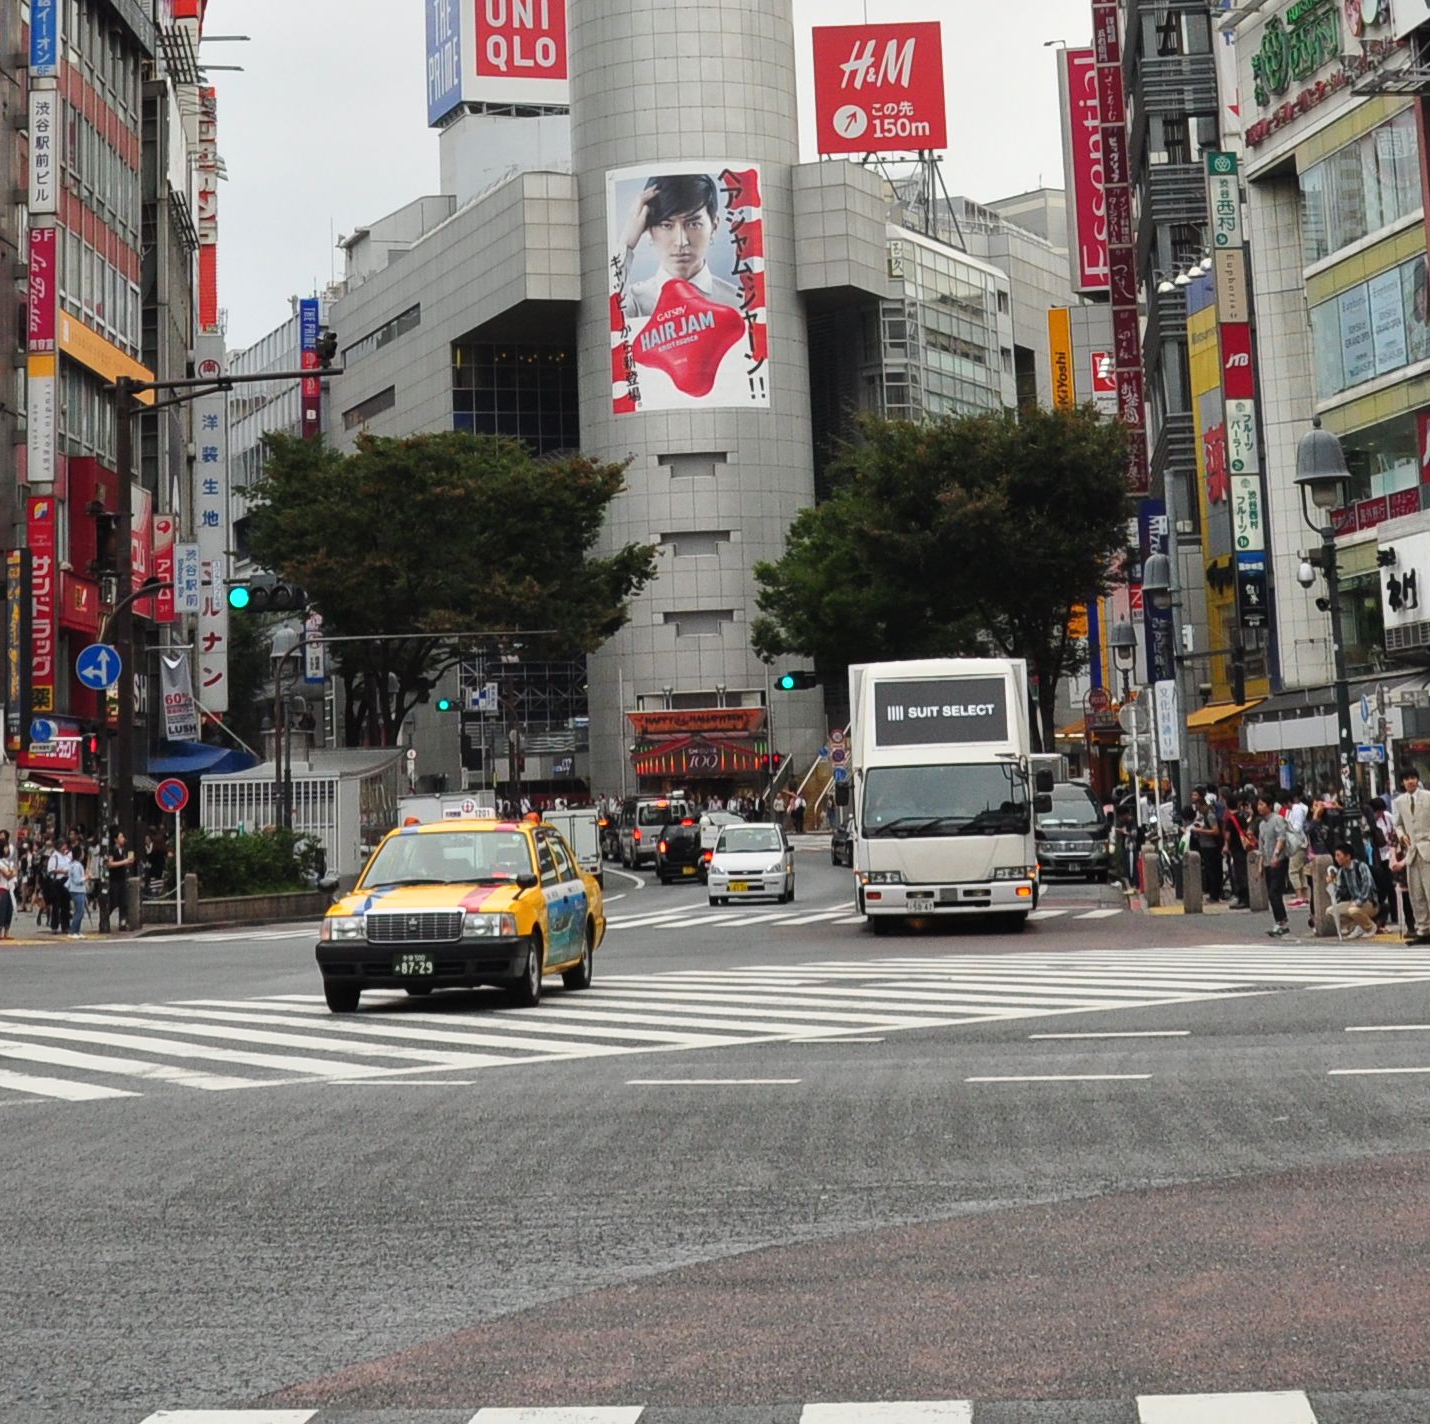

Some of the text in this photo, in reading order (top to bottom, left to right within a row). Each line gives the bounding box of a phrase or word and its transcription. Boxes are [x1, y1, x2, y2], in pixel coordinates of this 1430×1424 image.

[488, 34, 558, 70] QLO
[839, 37, 917, 91] H&M
[36, 65, 51, 76] 6F
[428, 43, 461, 107] PRIME
[872, 101, 914, 117] この先
[872, 118, 931, 138] 150m
[34, 101, 51, 204] 渋谷駅前ビル
[31, 229, 55, 242] 5F
[1226, 254, 1236, 310] Euphoria
[303, 307, 316, 327] THE
[640, 310, 716, 353] HAIR JAM
[656, 305, 687, 322] GATSBY
[303, 330, 317, 350] PRIME
[1225, 352, 1249, 369] JTB
[1231, 419, 1242, 458] パーラー
[1242, 414, 1254, 452] フルーツ
[201, 413, 220, 528] 洋装生地
[1235, 495, 1248, 534] フルーツ
[157, 558, 171, 600] アコム
[184, 549, 198, 607] 渋谷駅前
[31, 555, 52, 677] サンドラッグ
[165, 692, 193, 705] 60%
[907, 703, 995, 719] SUIT SELECT
[168, 724, 197, 735] LUSH
[474, 809, 491, 818] 1201
